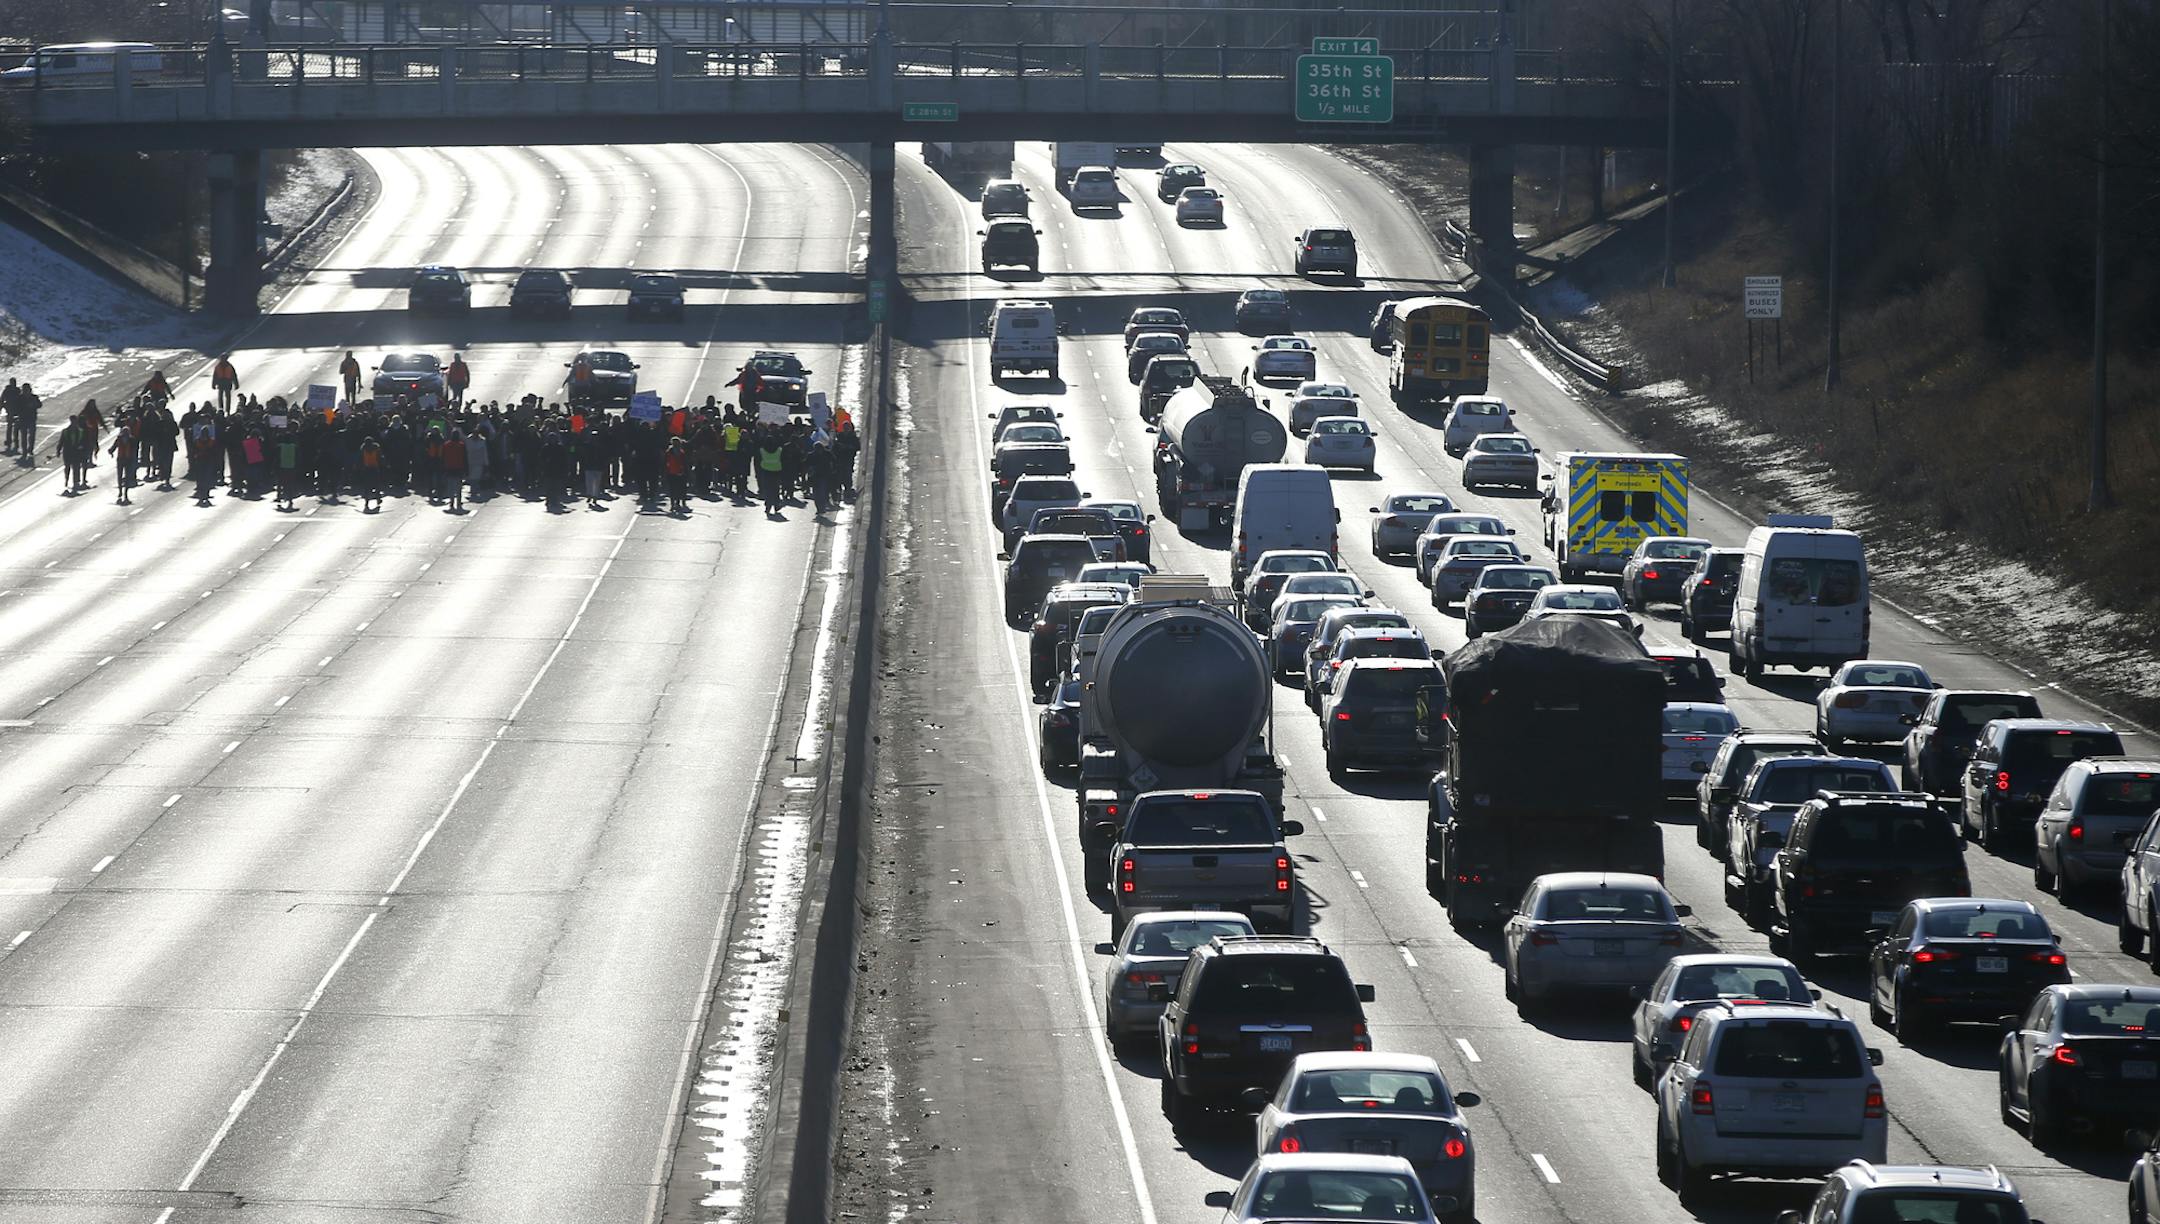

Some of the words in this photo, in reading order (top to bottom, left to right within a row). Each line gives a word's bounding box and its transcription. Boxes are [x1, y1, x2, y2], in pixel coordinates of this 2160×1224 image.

[1319, 42, 1347, 52] EXIT
[1353, 41, 1372, 54] 14
[1308, 64, 1352, 78] 35th
[1362, 64, 1382, 78] St
[1308, 84, 1351, 97] 36th
[1362, 85, 1381, 98] St
[1343, 104, 1370, 114] MILE
[1749, 298, 1777, 306] BUSES
